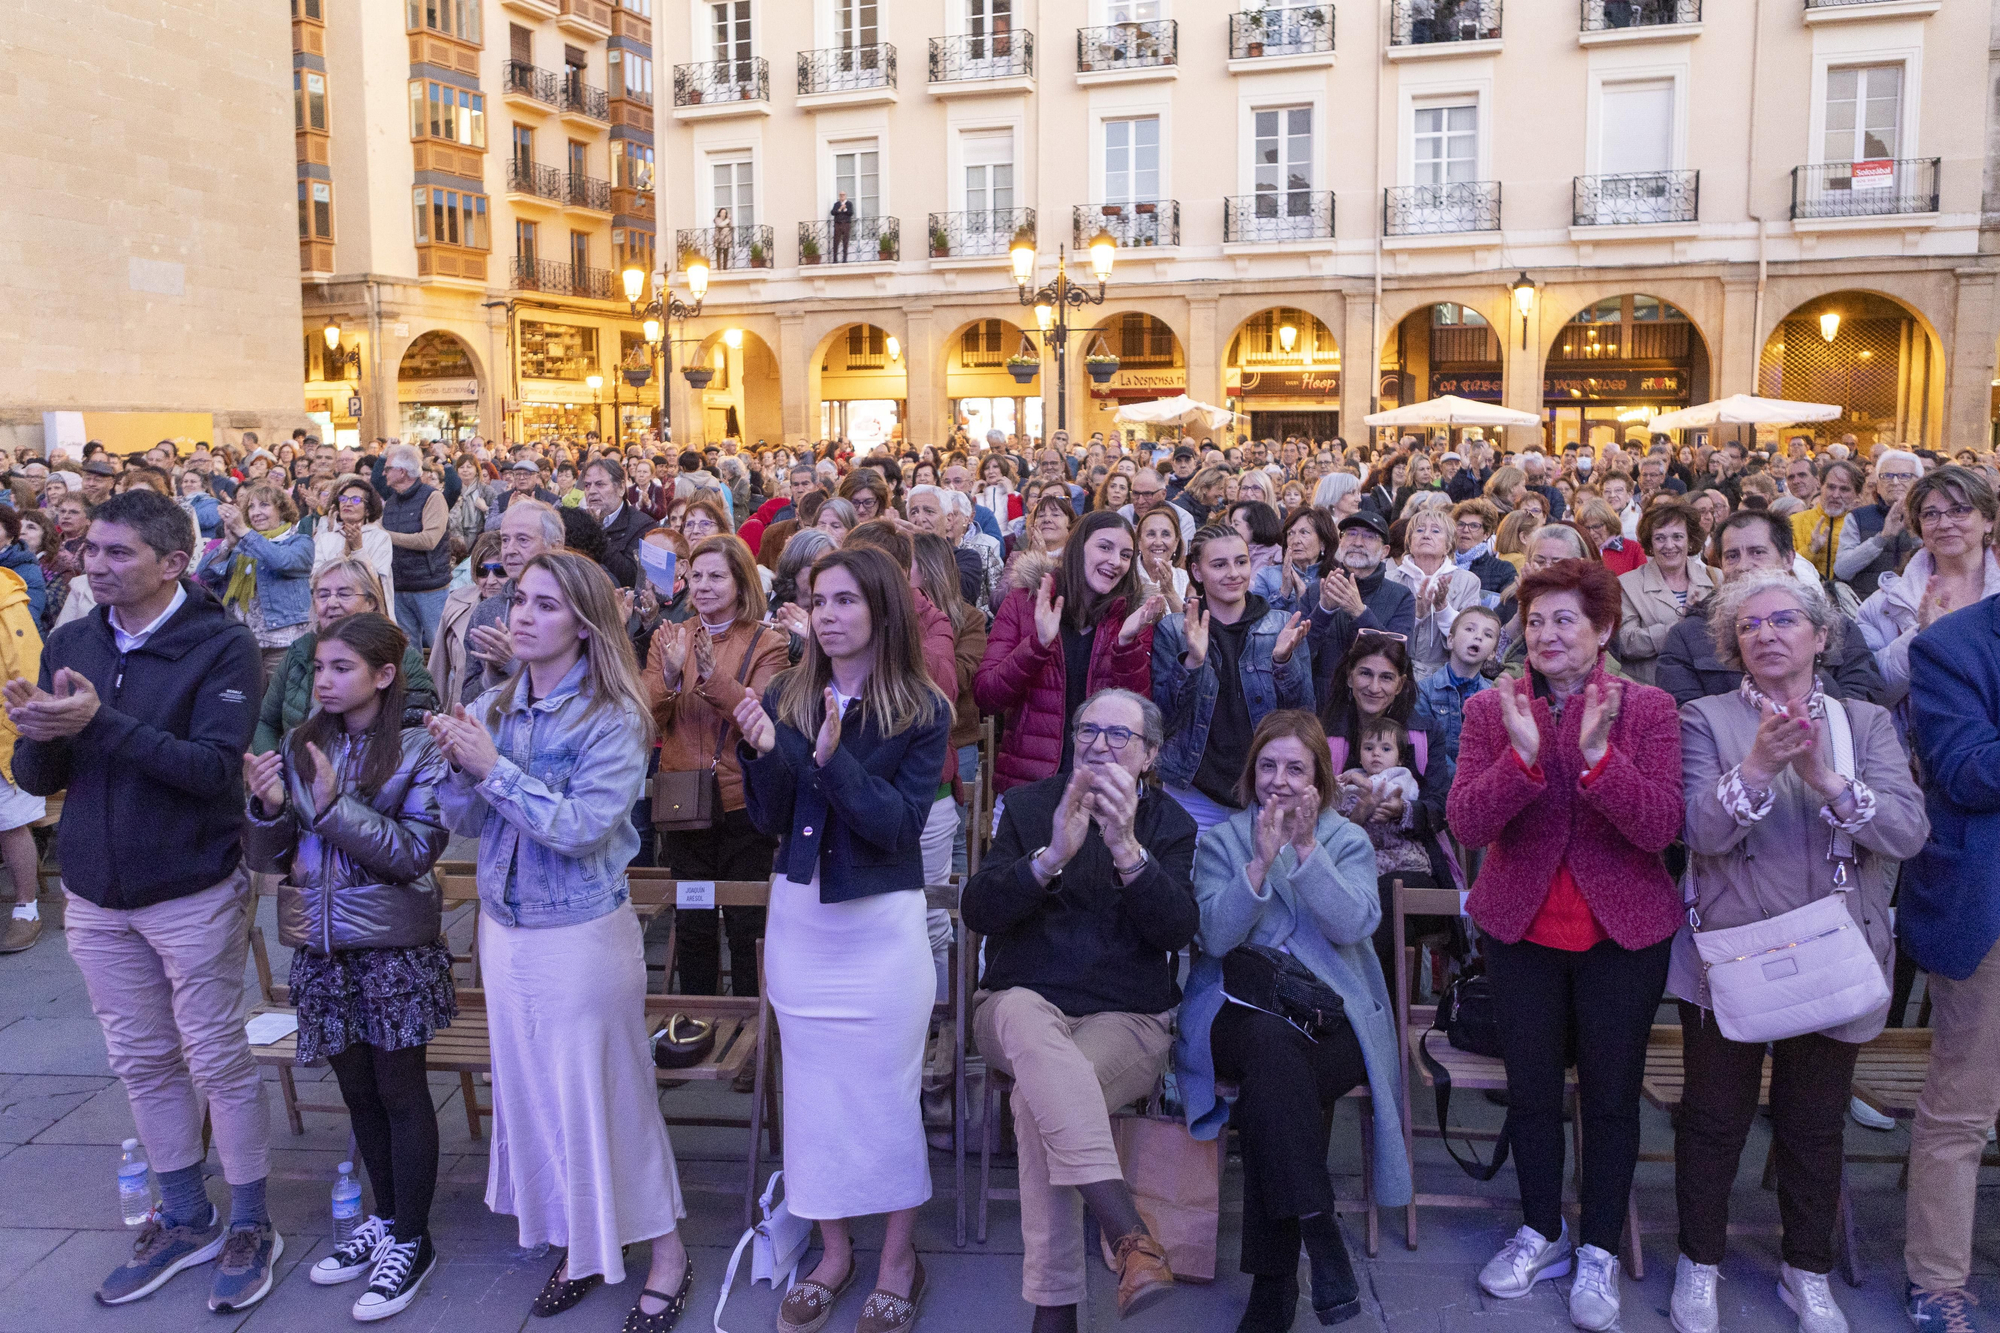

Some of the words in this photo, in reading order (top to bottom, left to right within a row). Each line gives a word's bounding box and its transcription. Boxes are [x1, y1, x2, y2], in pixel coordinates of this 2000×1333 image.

[1120, 373, 1131, 386] La
[1134, 373, 1174, 388] despensa
[1302, 373, 1336, 392] Hoop
[350, 398, 360, 415] P
[685, 886, 705, 894] JOAQUÍN
